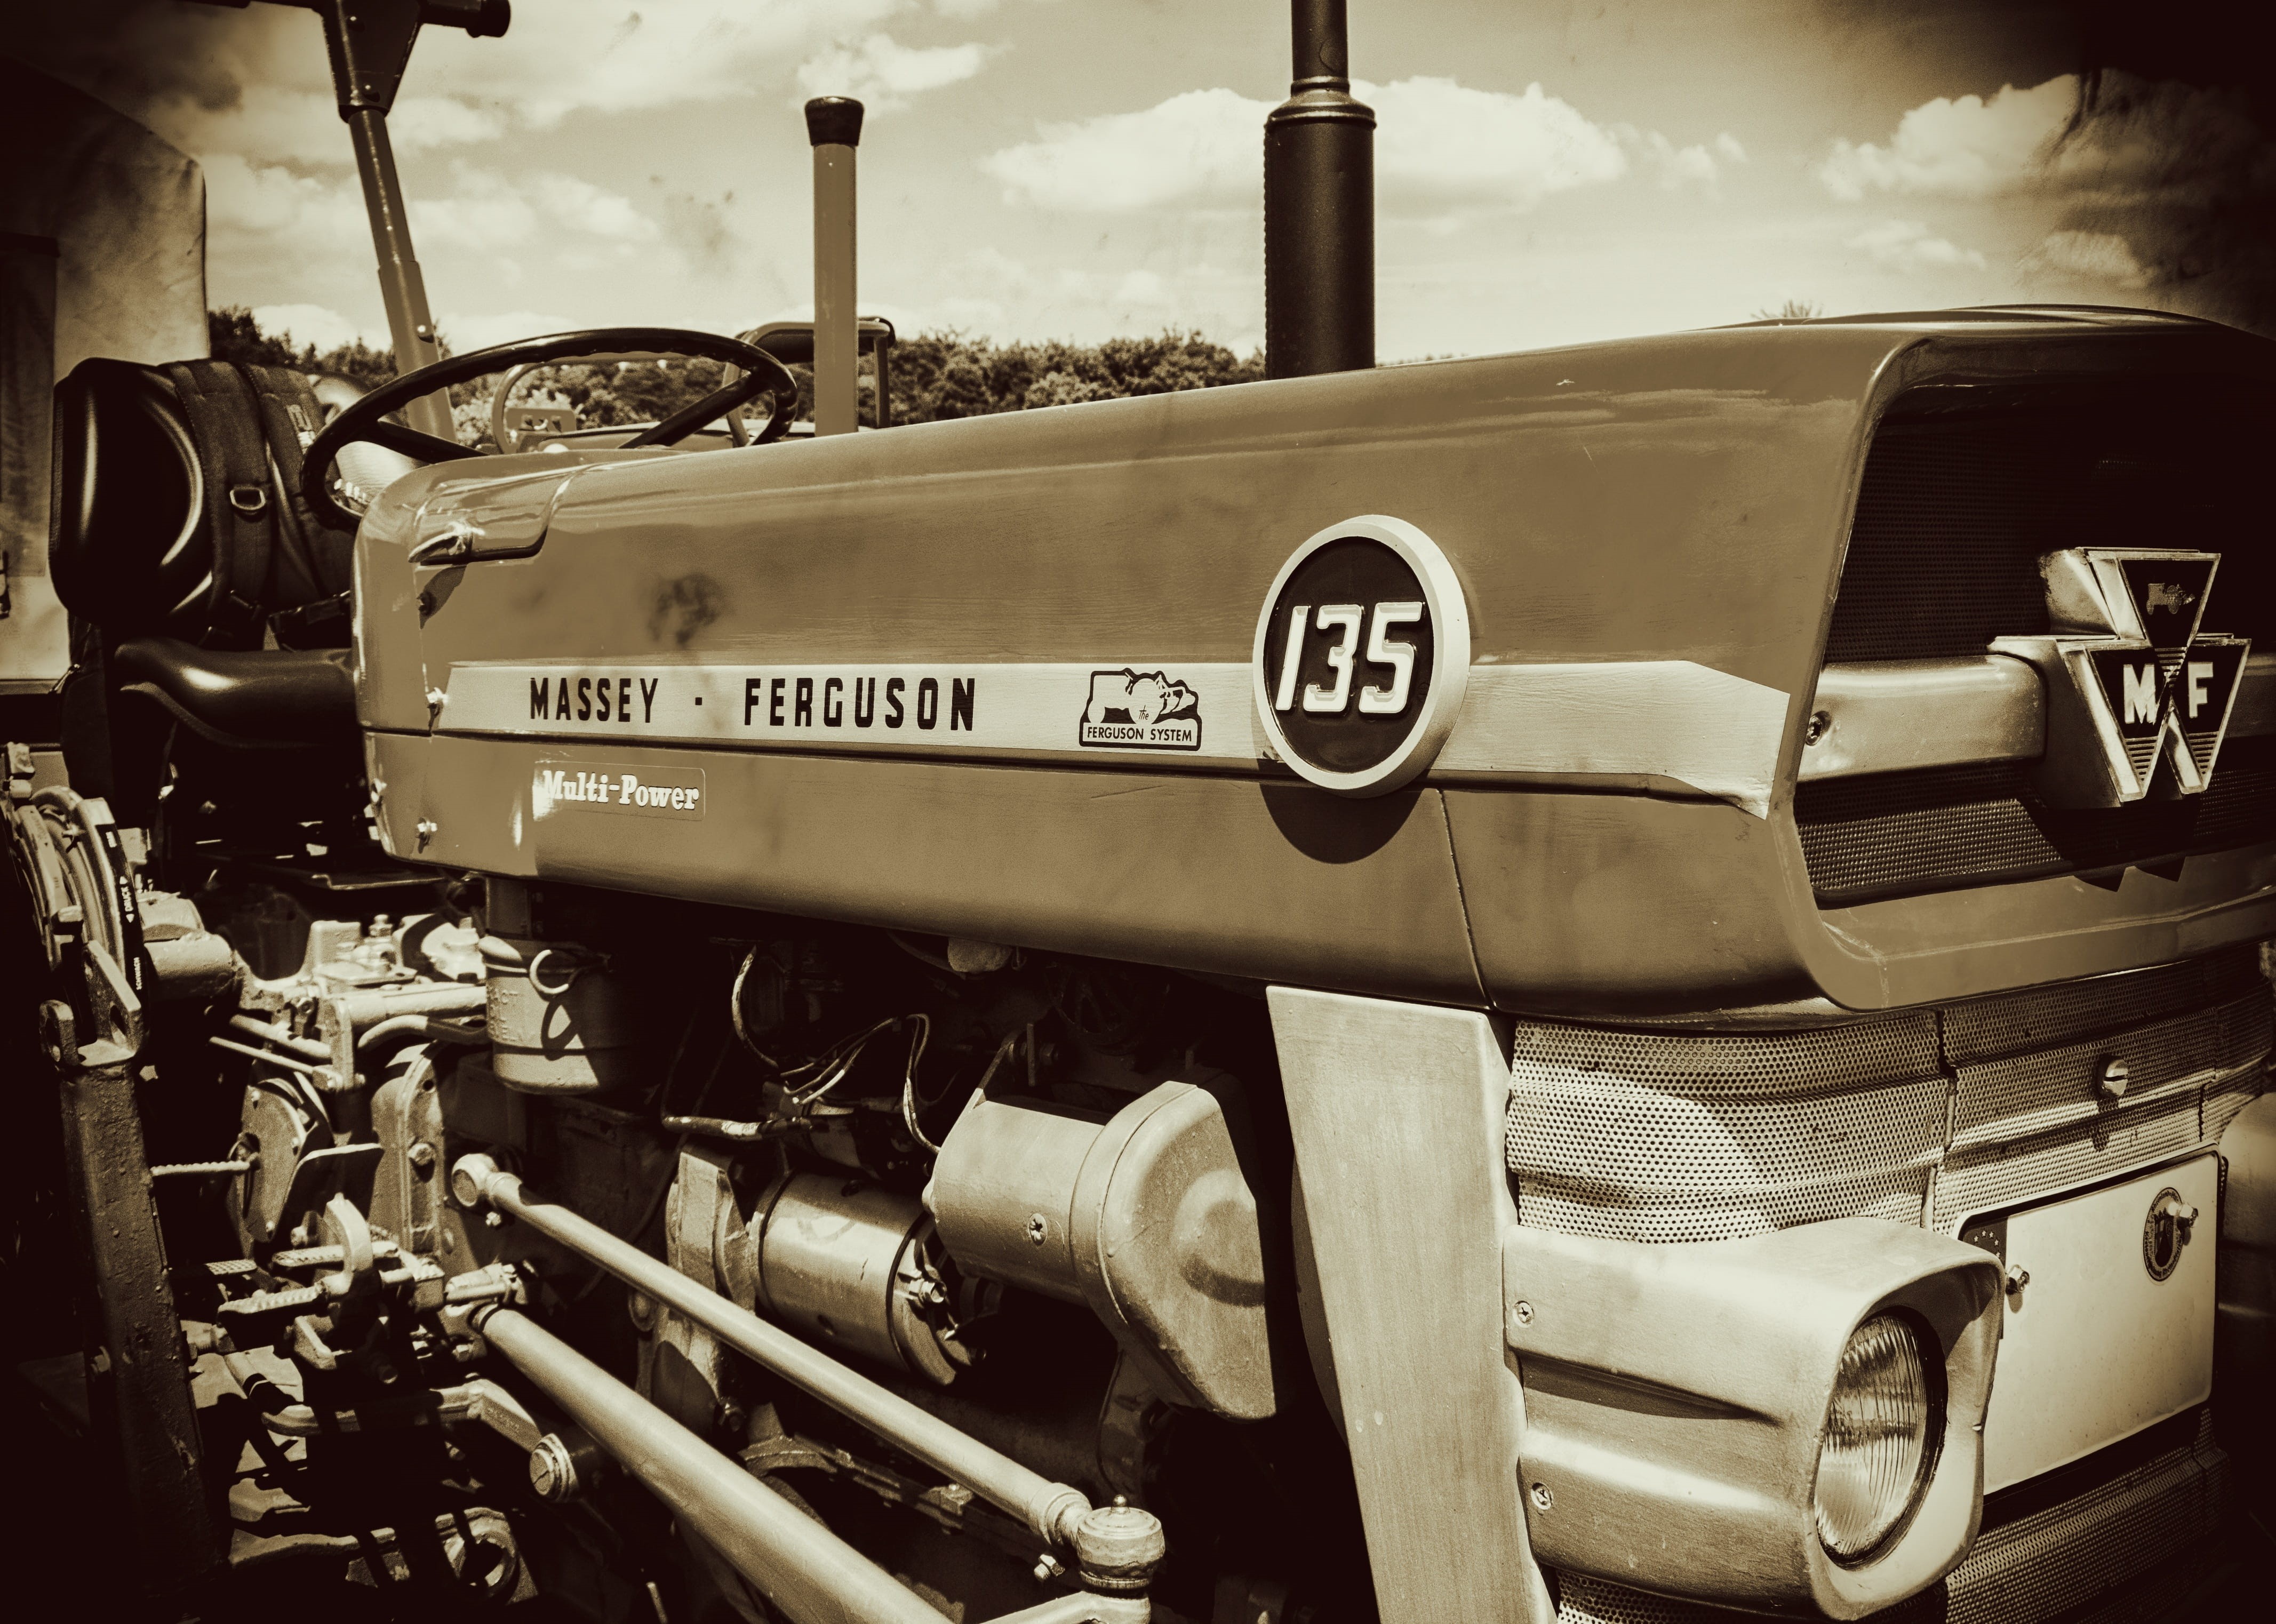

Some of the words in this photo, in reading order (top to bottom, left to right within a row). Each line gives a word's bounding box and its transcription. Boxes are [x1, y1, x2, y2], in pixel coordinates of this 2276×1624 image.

[1276, 602, 1423, 714] 135
[530, 677, 659, 723] MASSEY
[745, 677, 976, 731] FERGUSON
[1087, 726, 1144, 739] FERGUSON
[1151, 729, 1192, 741] SYSTEM
[542, 770, 699, 810] Multi-Power
[121, 886, 133, 912] DRUCK
